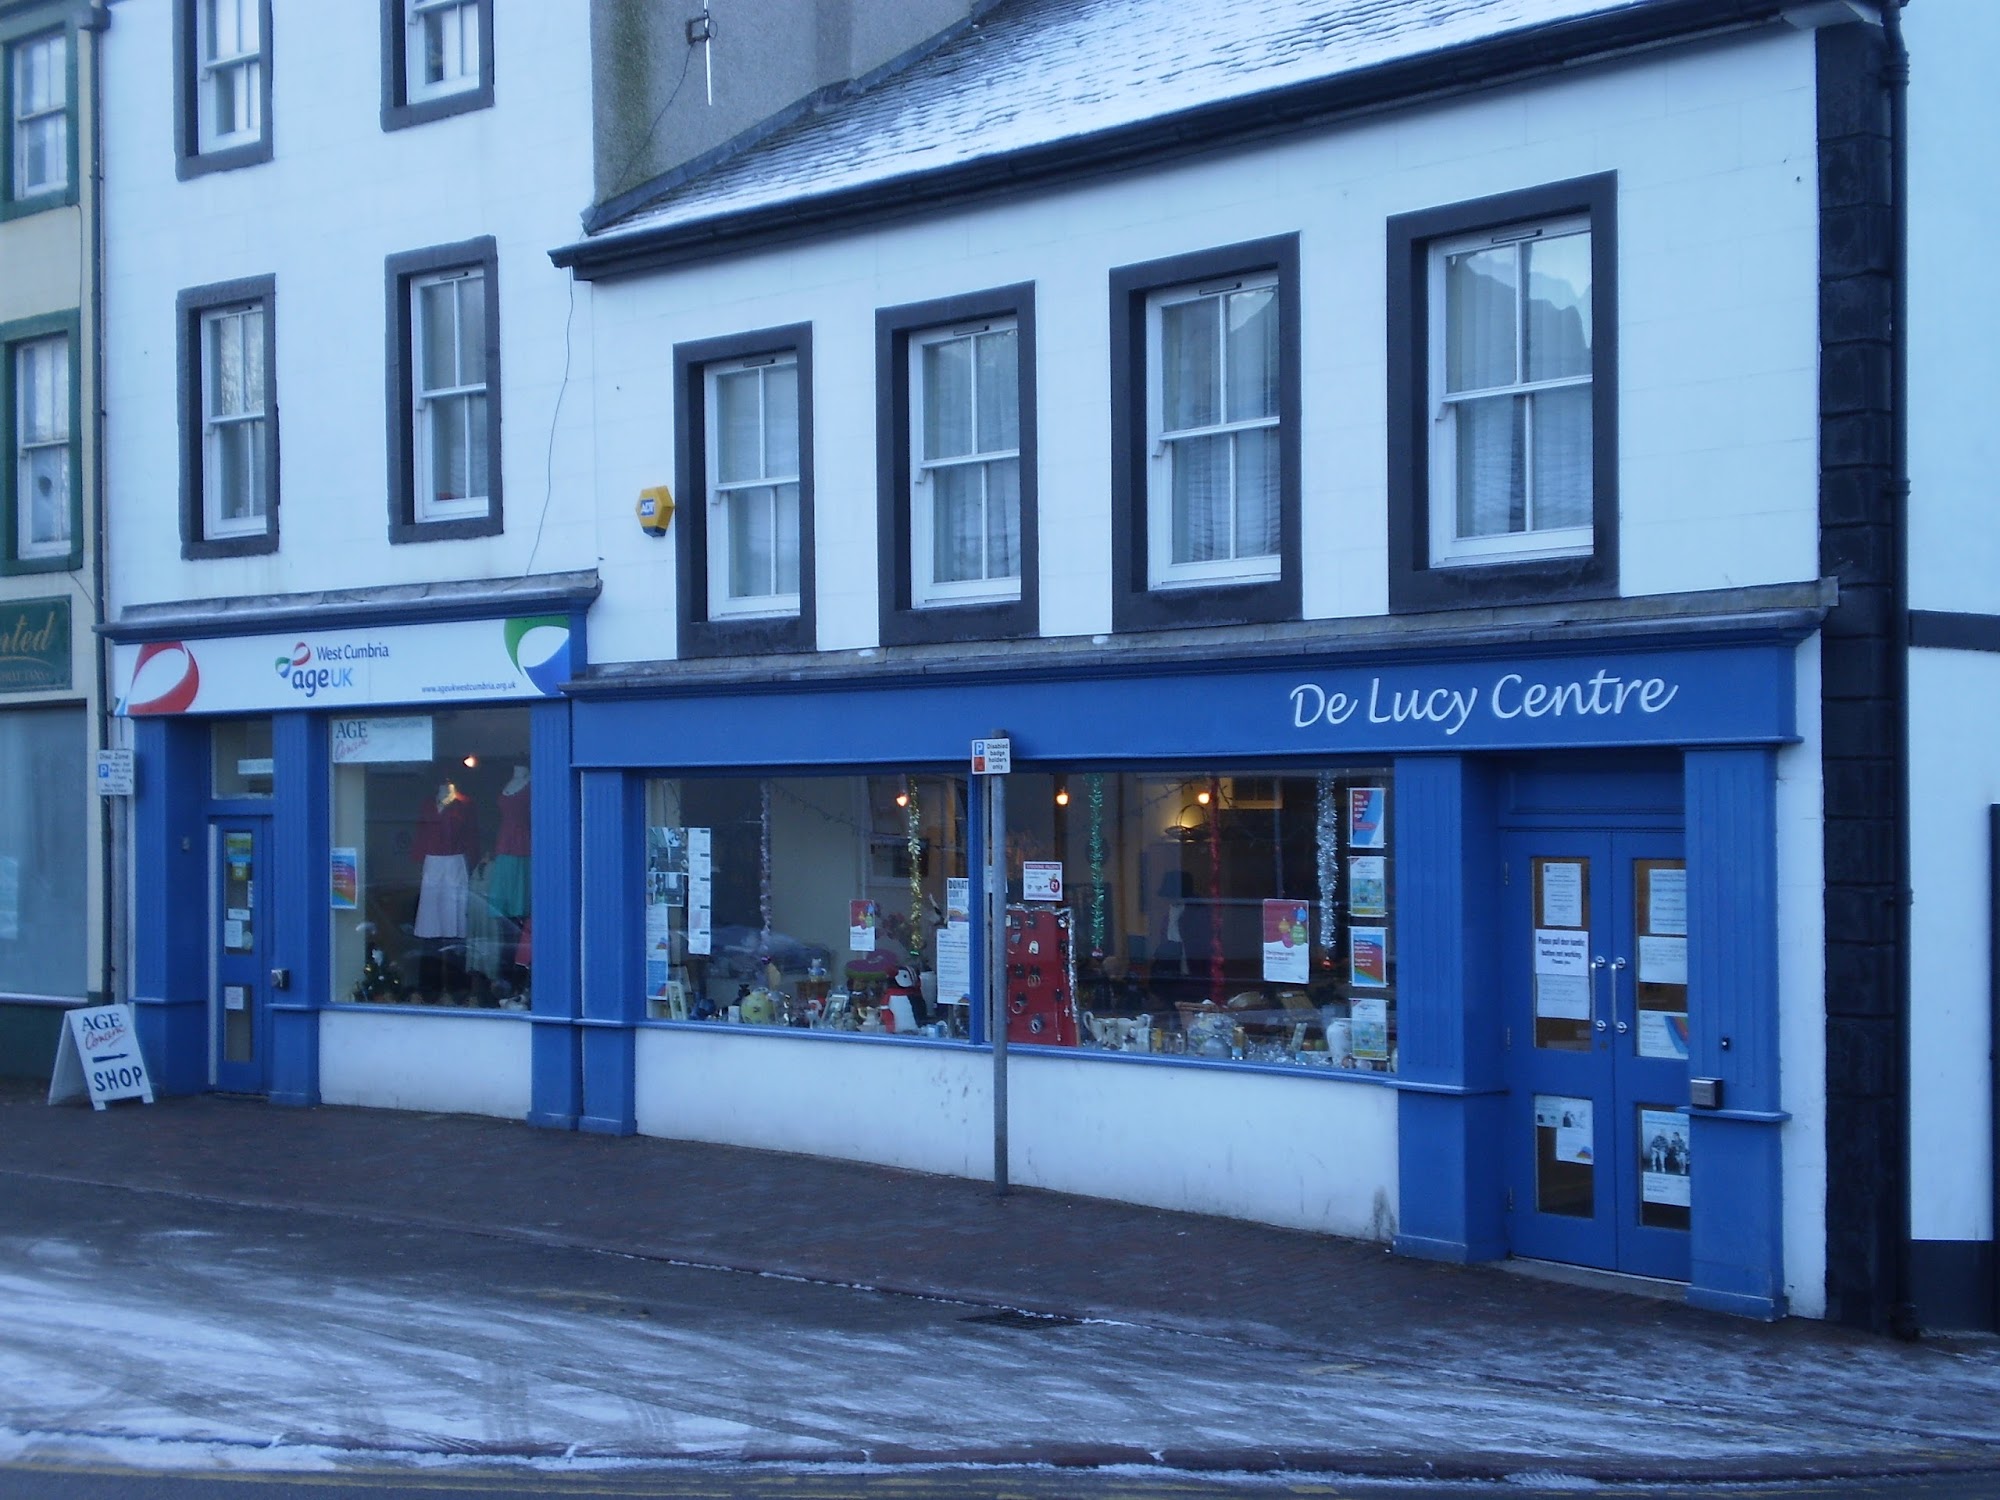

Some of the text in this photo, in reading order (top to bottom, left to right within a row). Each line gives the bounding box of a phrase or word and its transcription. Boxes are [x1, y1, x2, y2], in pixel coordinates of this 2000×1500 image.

[316, 642, 389, 660] West Cumbria
[1289, 668, 1678, 735] De Lucy Centre
[336, 721, 368, 739] AGE
[82, 1013, 122, 1032] AGE
[94, 1066, 142, 1092] SHOP
